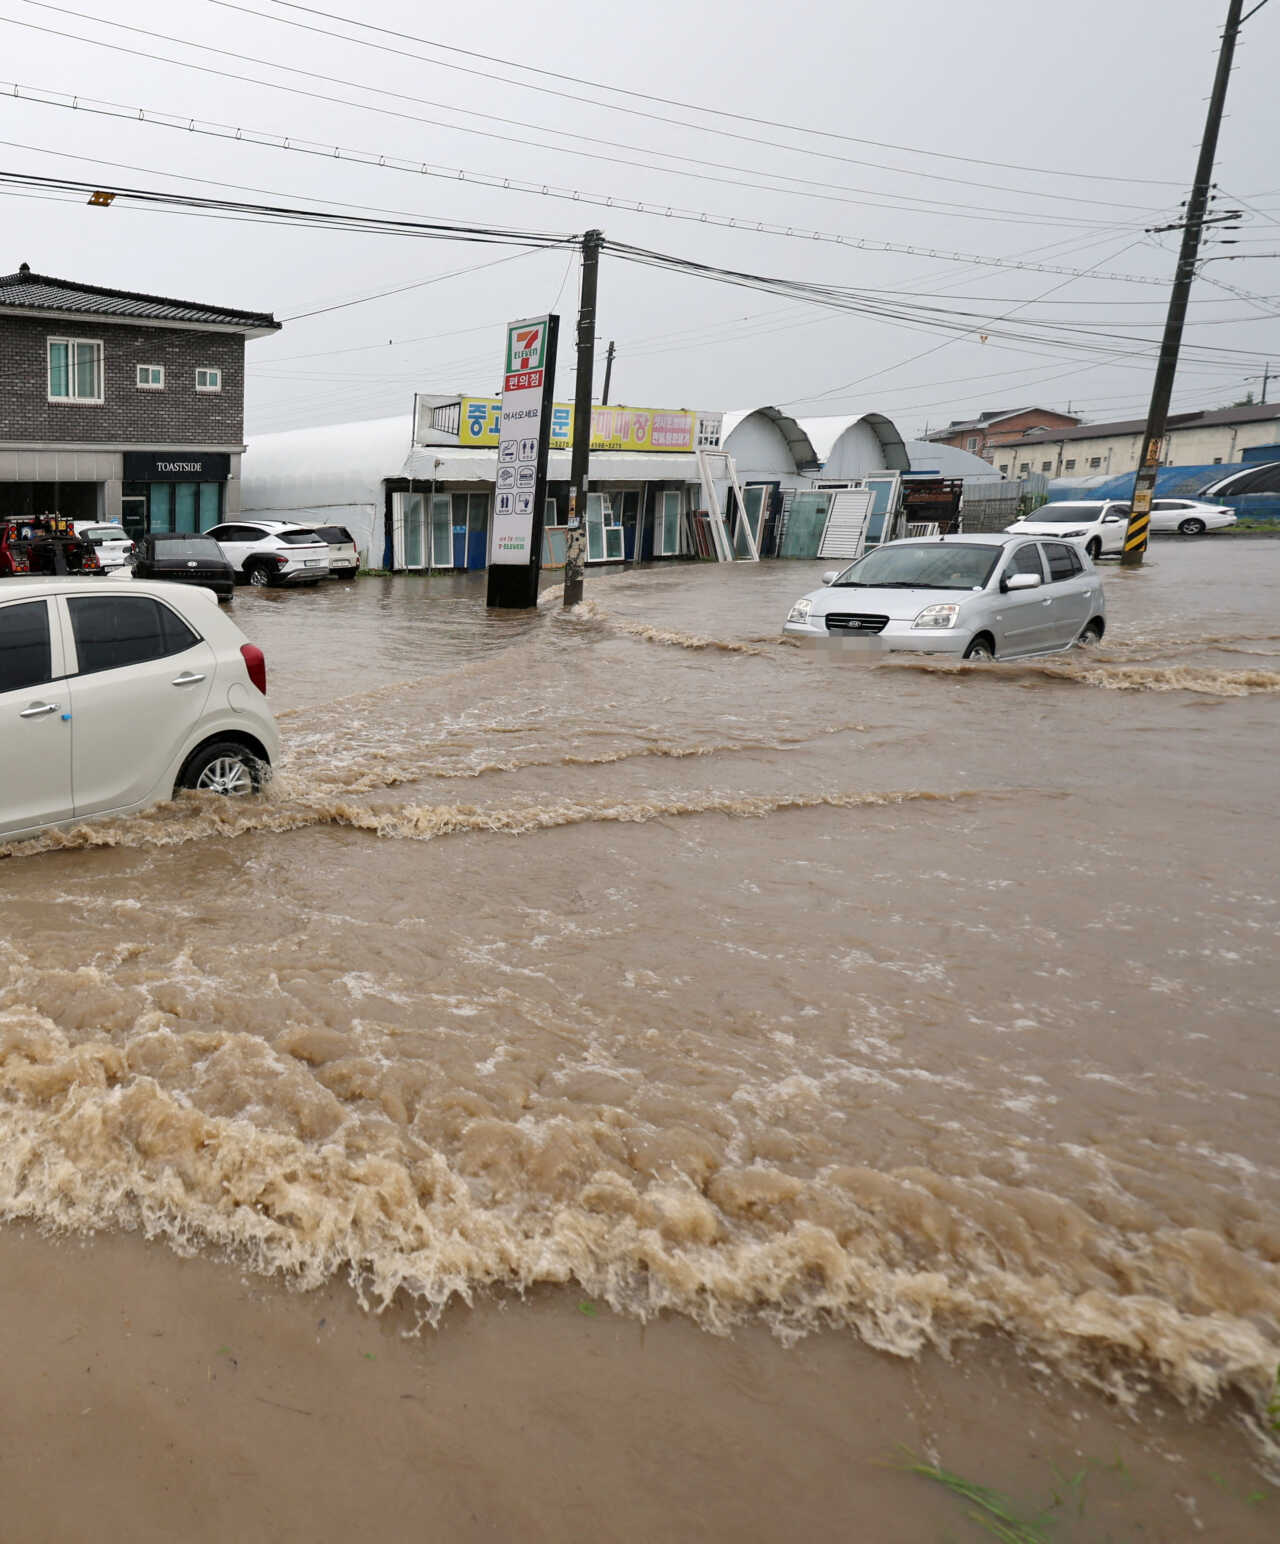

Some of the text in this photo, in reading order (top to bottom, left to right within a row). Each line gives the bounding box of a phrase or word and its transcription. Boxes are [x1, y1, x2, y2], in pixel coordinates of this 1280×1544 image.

[516, 329, 539, 370] 7
[509, 372, 540, 389] 편의점
[503, 409, 539, 421] 어서오세요
[156, 462, 202, 472] TOASTSIDE
